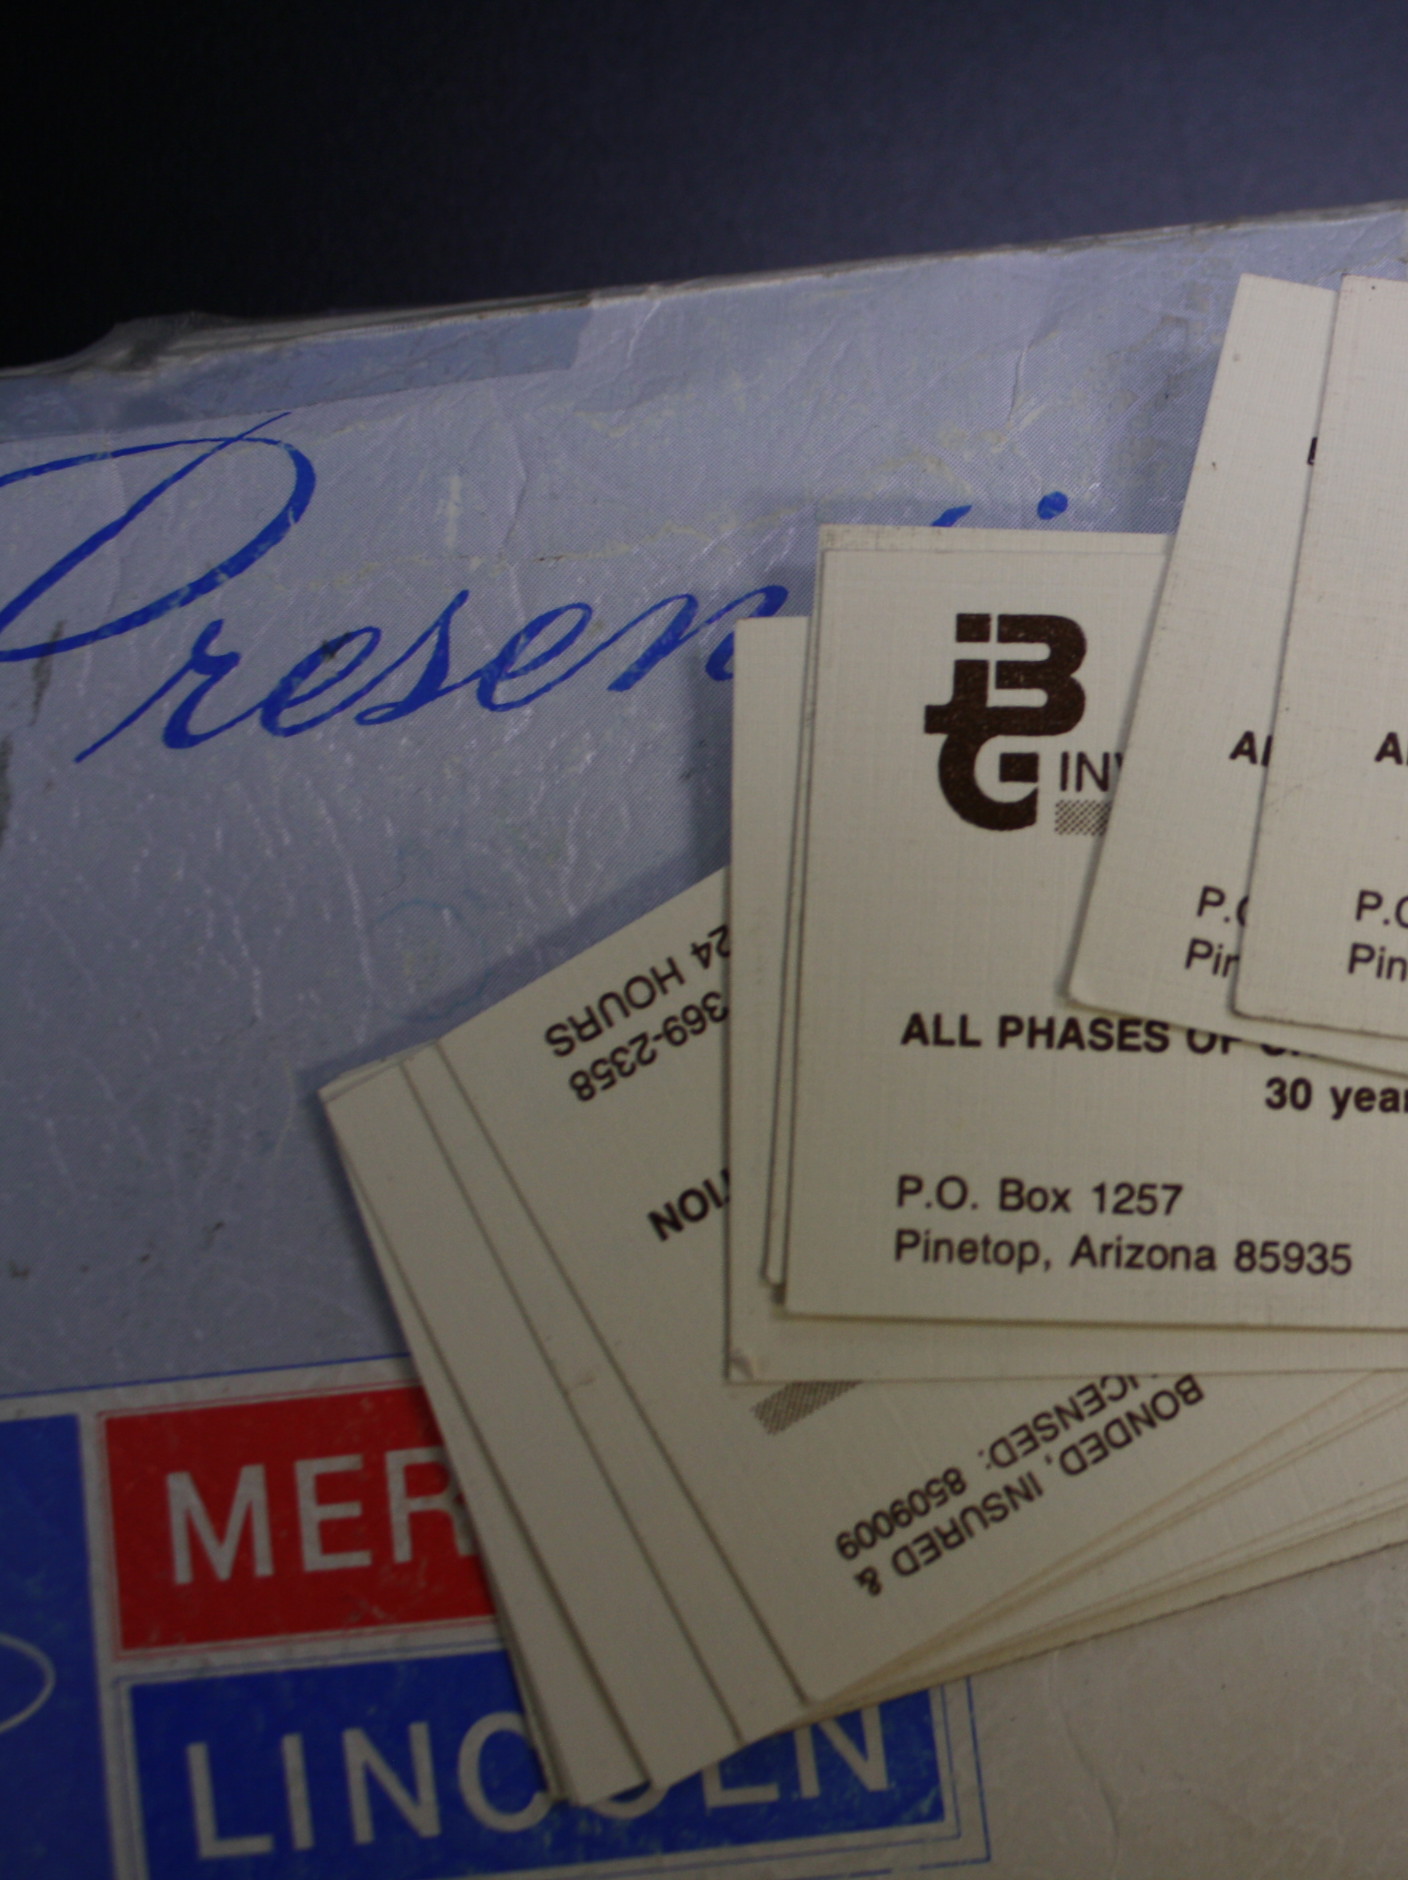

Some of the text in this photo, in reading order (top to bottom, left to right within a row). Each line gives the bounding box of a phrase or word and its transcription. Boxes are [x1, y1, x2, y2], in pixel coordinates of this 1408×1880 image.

[544, 923, 729, 1058] 24 HOURS
[569, 990, 729, 1103] 369-2358
[901, 1014, 982, 1048] ALL
[998, 1016, 1170, 1054] PHASES
[1266, 1077, 1313, 1112] 30
[897, 1175, 1184, 1217] P.O. Box 1257
[894, 1230, 1353, 1276] Pinetop, Arizona 85935
[835, 1374, 1142, 1560] ICENSED: 8509009
[853, 1373, 1205, 1597] BONDED, INSURED &
